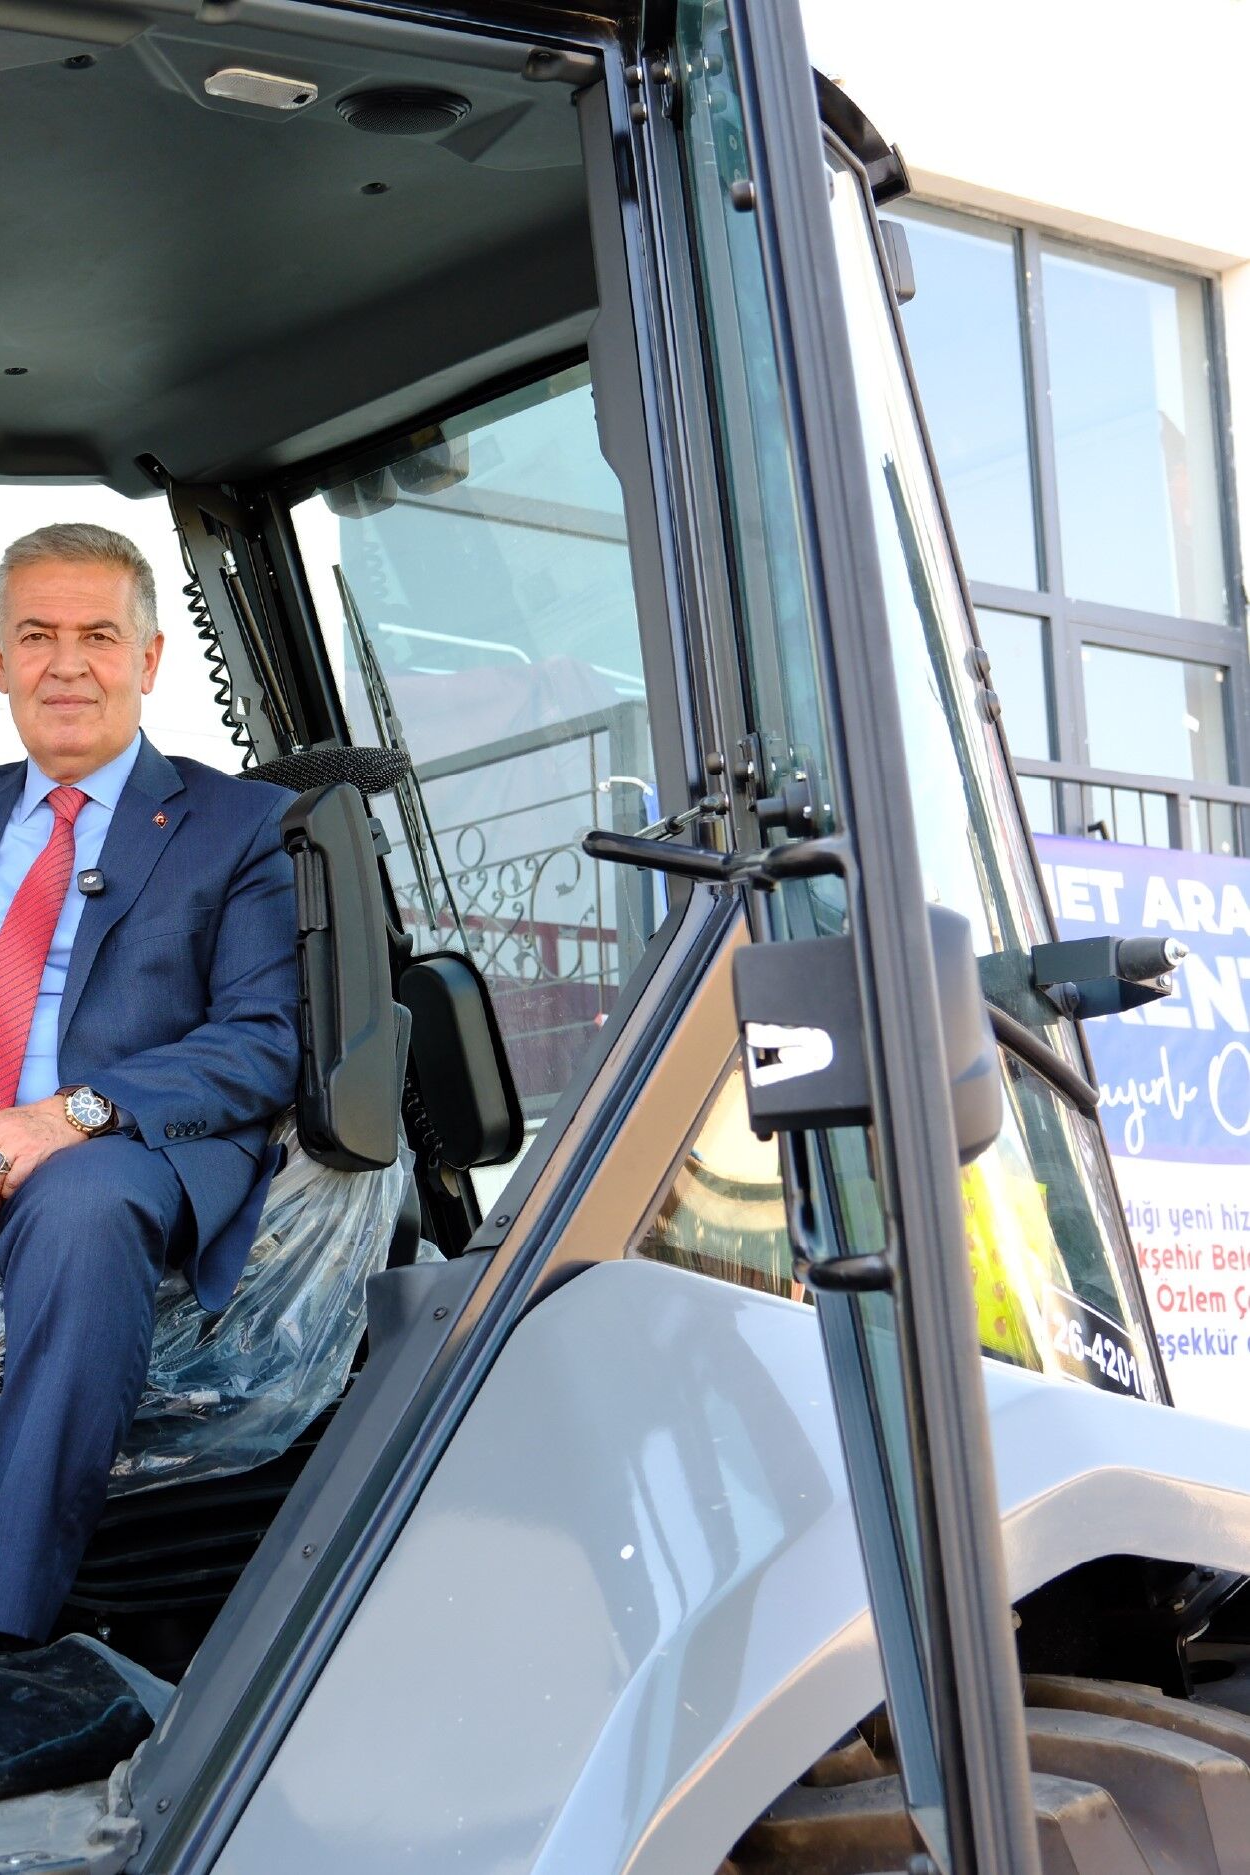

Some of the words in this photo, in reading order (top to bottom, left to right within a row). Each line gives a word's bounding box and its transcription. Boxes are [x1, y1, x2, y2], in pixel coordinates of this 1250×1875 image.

[1168, 1203, 1213, 1236] yeni
[1211, 1244, 1250, 1271] Bel
[1156, 1277, 1227, 1313] Özlem
